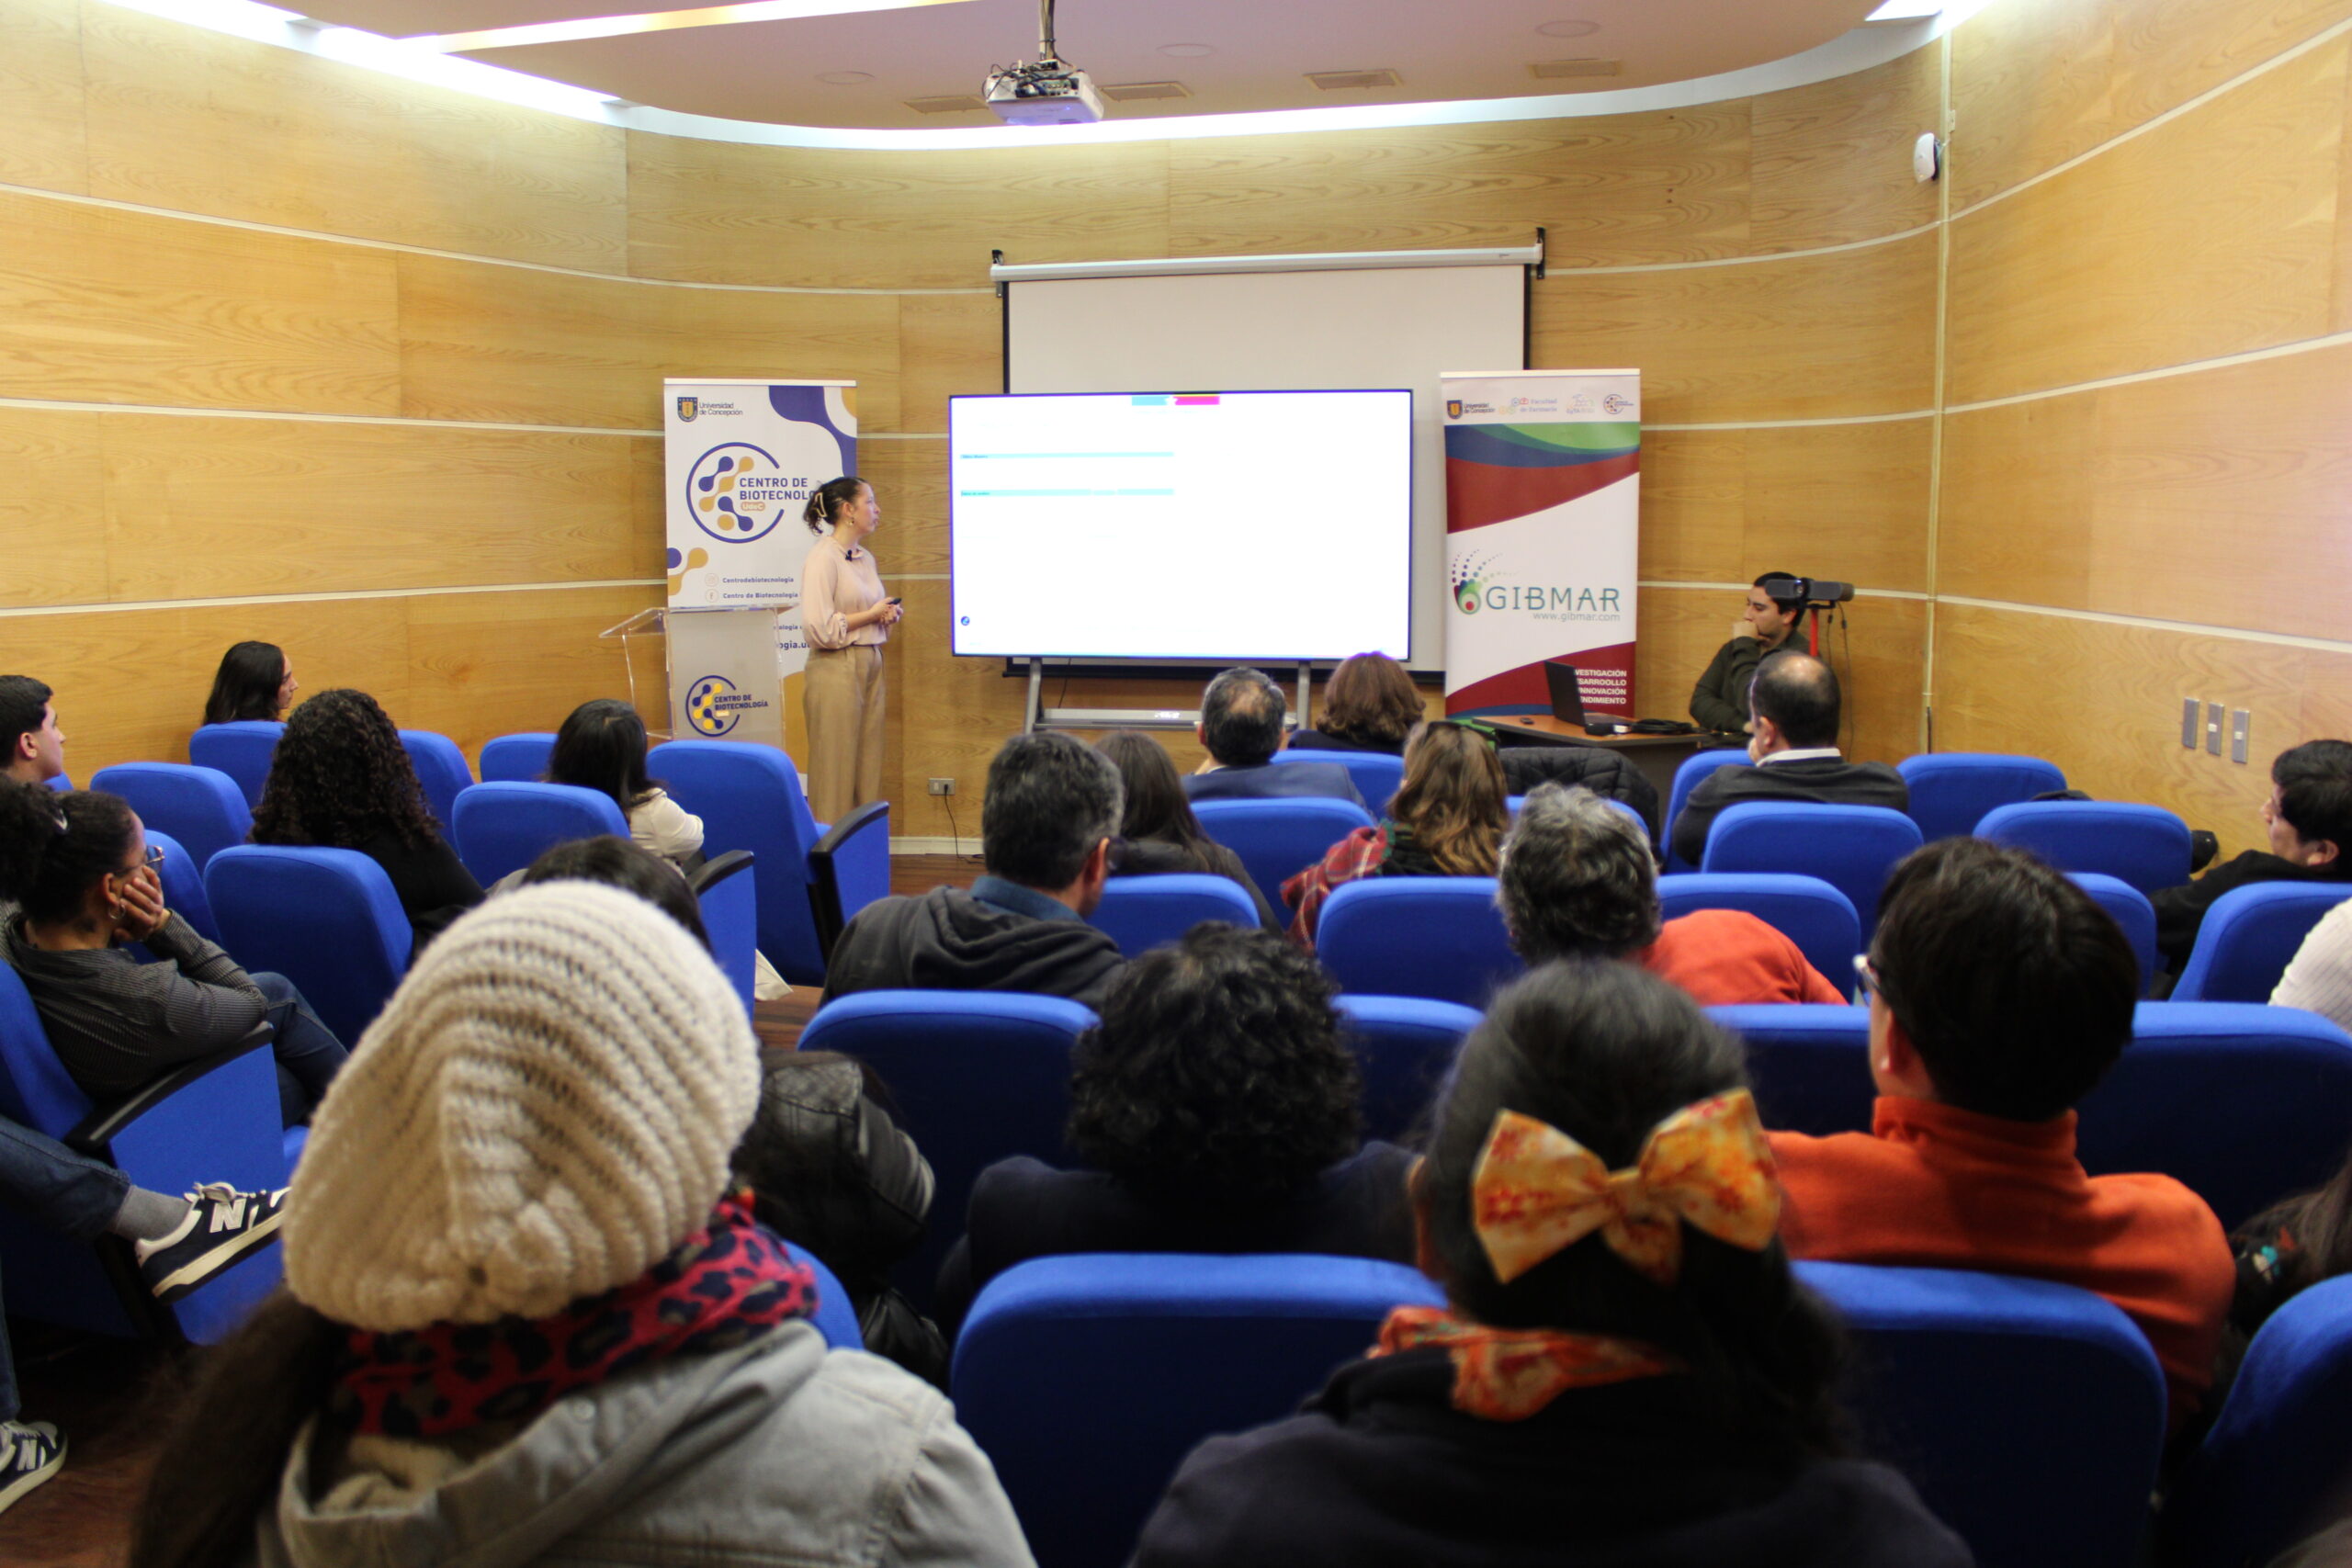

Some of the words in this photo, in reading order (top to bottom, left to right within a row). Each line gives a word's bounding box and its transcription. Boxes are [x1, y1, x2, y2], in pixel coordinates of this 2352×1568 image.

[740, 478, 788, 487] CENTRO
[792, 478, 808, 487] DE
[1486, 585, 1620, 612] GIBMAR
[1532, 612, 1621, 623] www.gibmar.com
[715, 695, 741, 704] CENTRO
